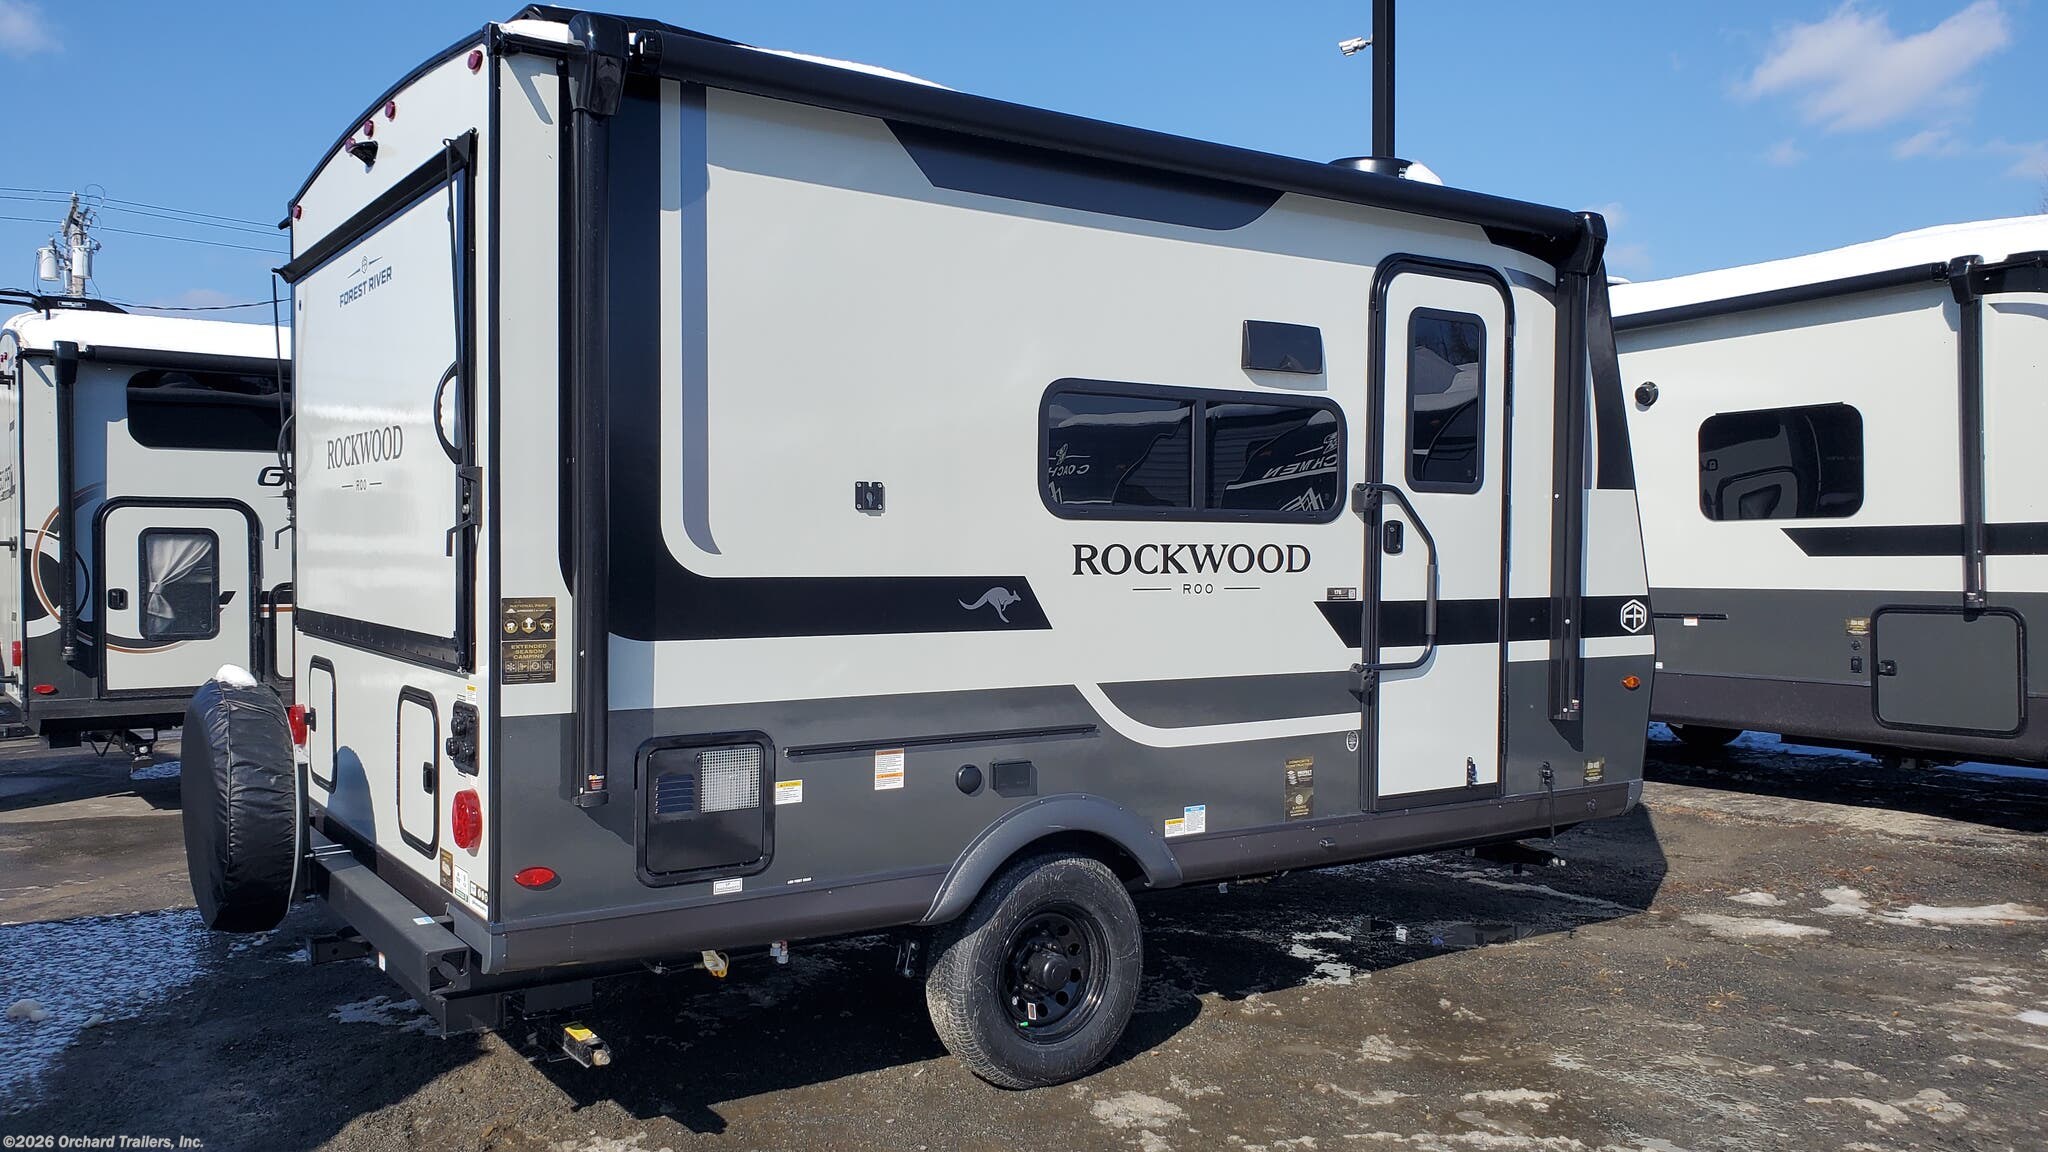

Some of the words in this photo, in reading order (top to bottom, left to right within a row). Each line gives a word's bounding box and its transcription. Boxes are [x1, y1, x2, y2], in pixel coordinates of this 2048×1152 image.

[339, 281, 367, 308] FOREST
[369, 265, 392, 292] RIVER
[327, 425, 403, 470] ROCKWOOD
[1072, 543, 1312, 576] ROCKWOOD
[1182, 583, 1214, 595] ROO
